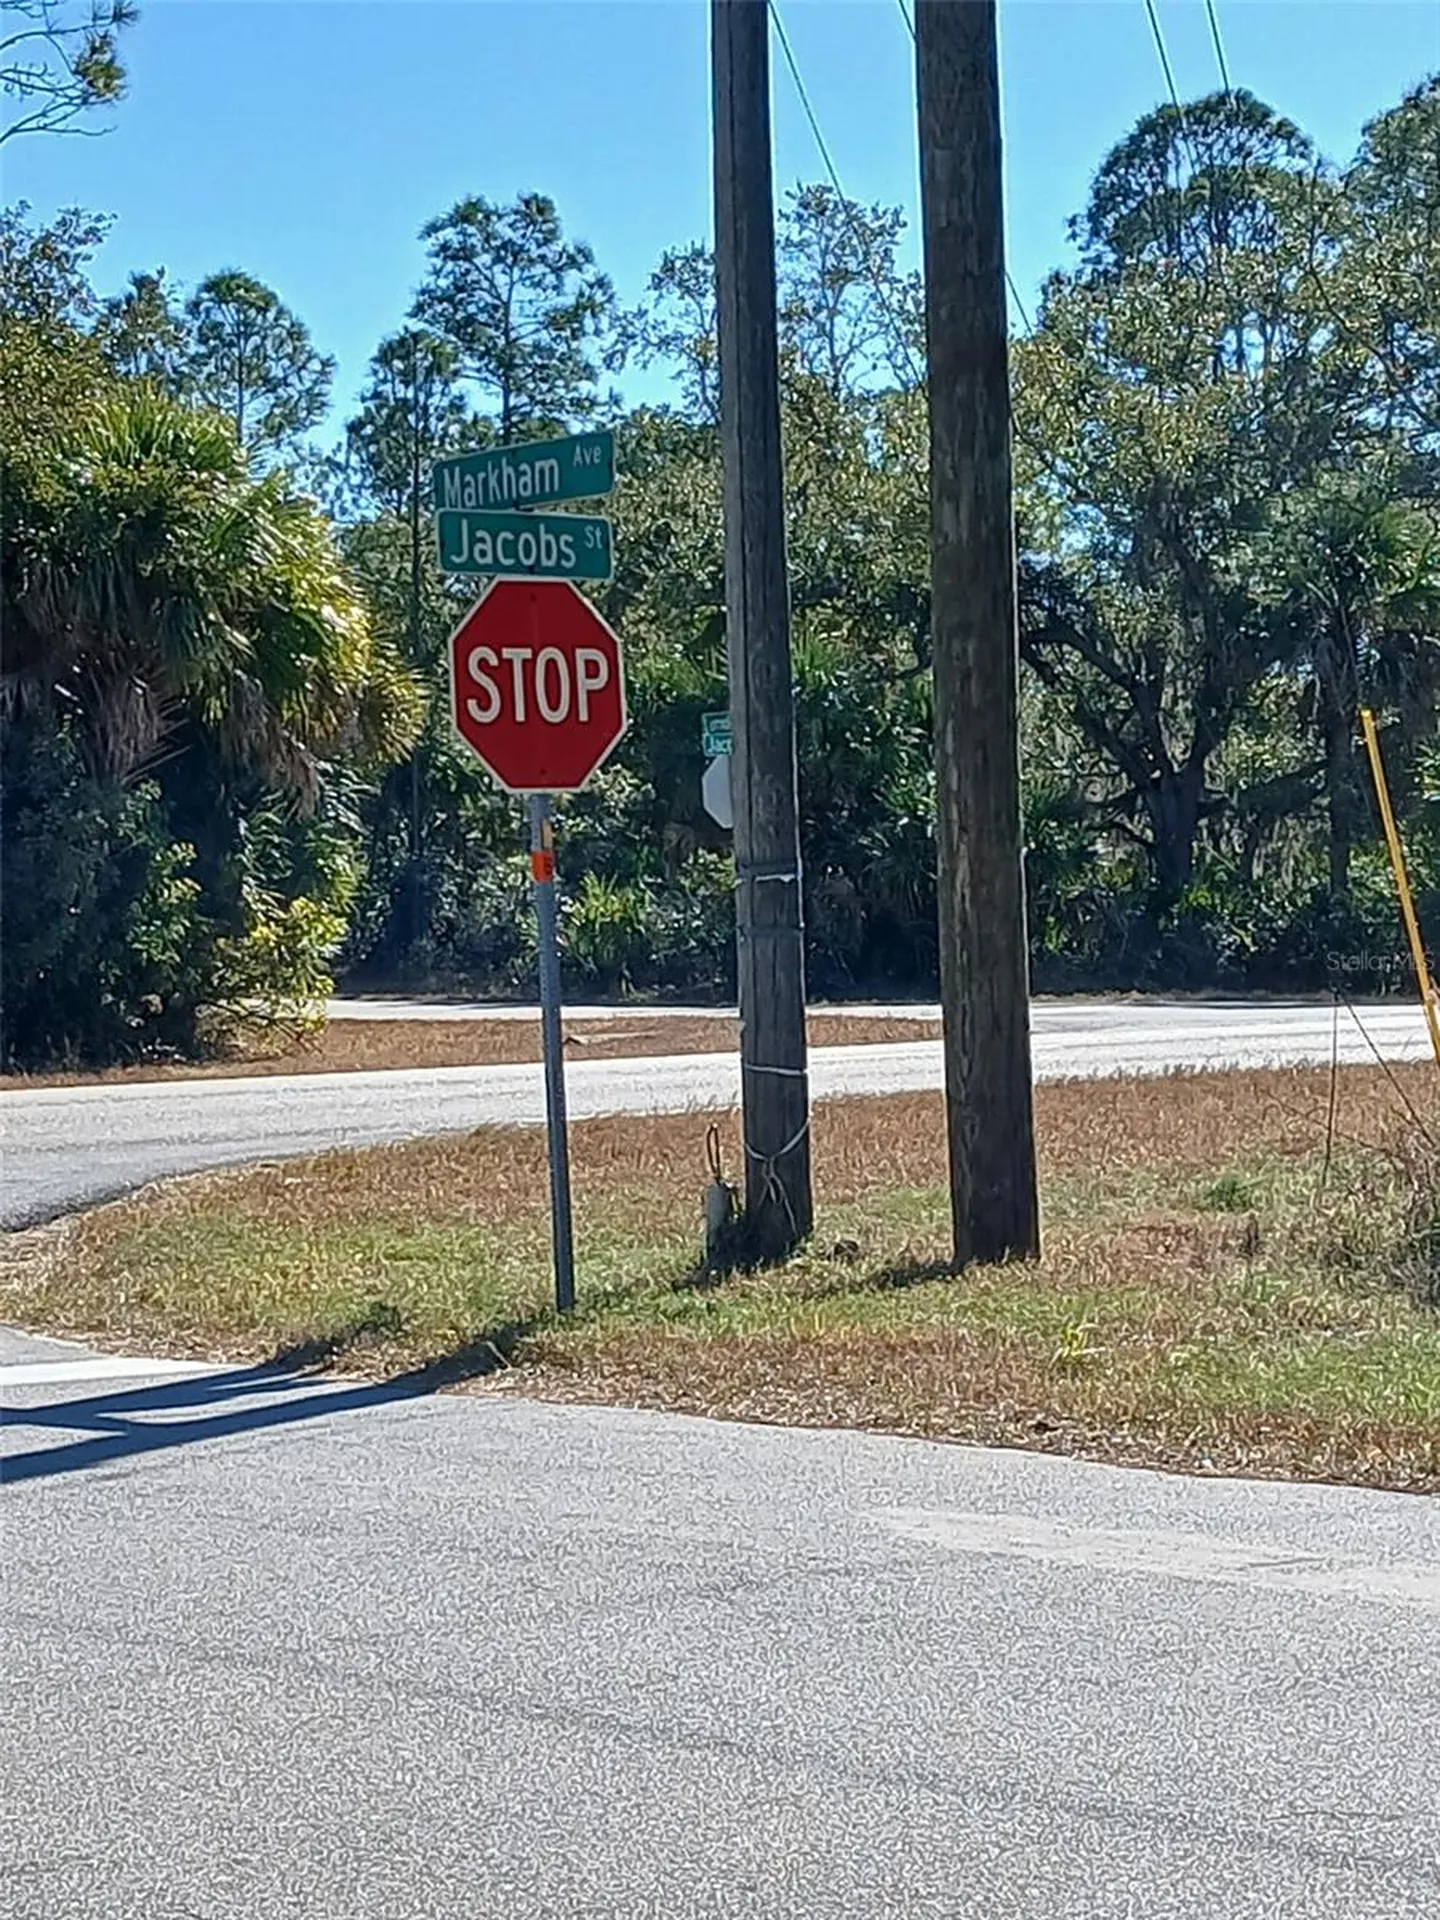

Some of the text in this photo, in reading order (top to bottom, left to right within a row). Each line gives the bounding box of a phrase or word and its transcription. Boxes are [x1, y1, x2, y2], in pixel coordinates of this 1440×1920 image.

[442, 444, 602, 510] Markham Ave
[450, 518, 602, 569] Jacobs St
[466, 645, 610, 724] STOP
